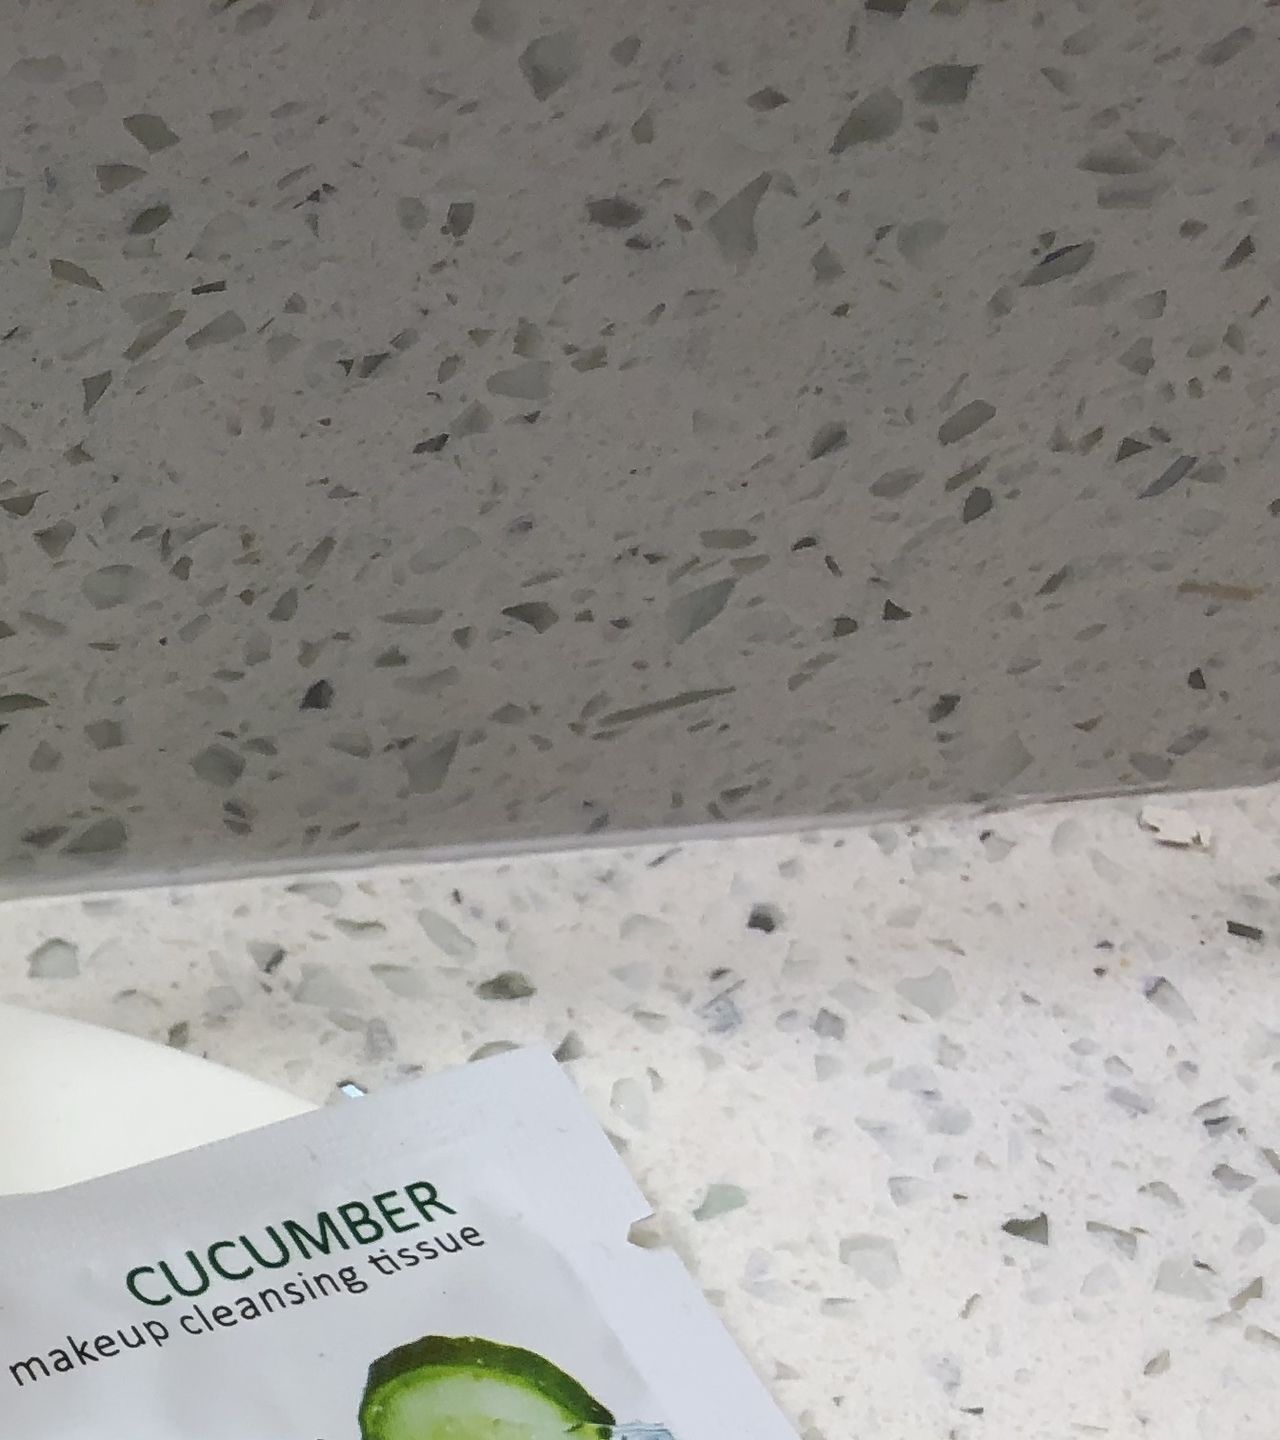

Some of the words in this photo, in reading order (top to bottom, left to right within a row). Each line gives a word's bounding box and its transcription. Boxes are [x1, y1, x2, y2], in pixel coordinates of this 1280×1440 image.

[8, 1317, 170, 1387] makeup
[179, 1263, 370, 1336] cleansing
[367, 1225, 486, 1276] tissue
[125, 1179, 458, 1307] CUCUMBER
